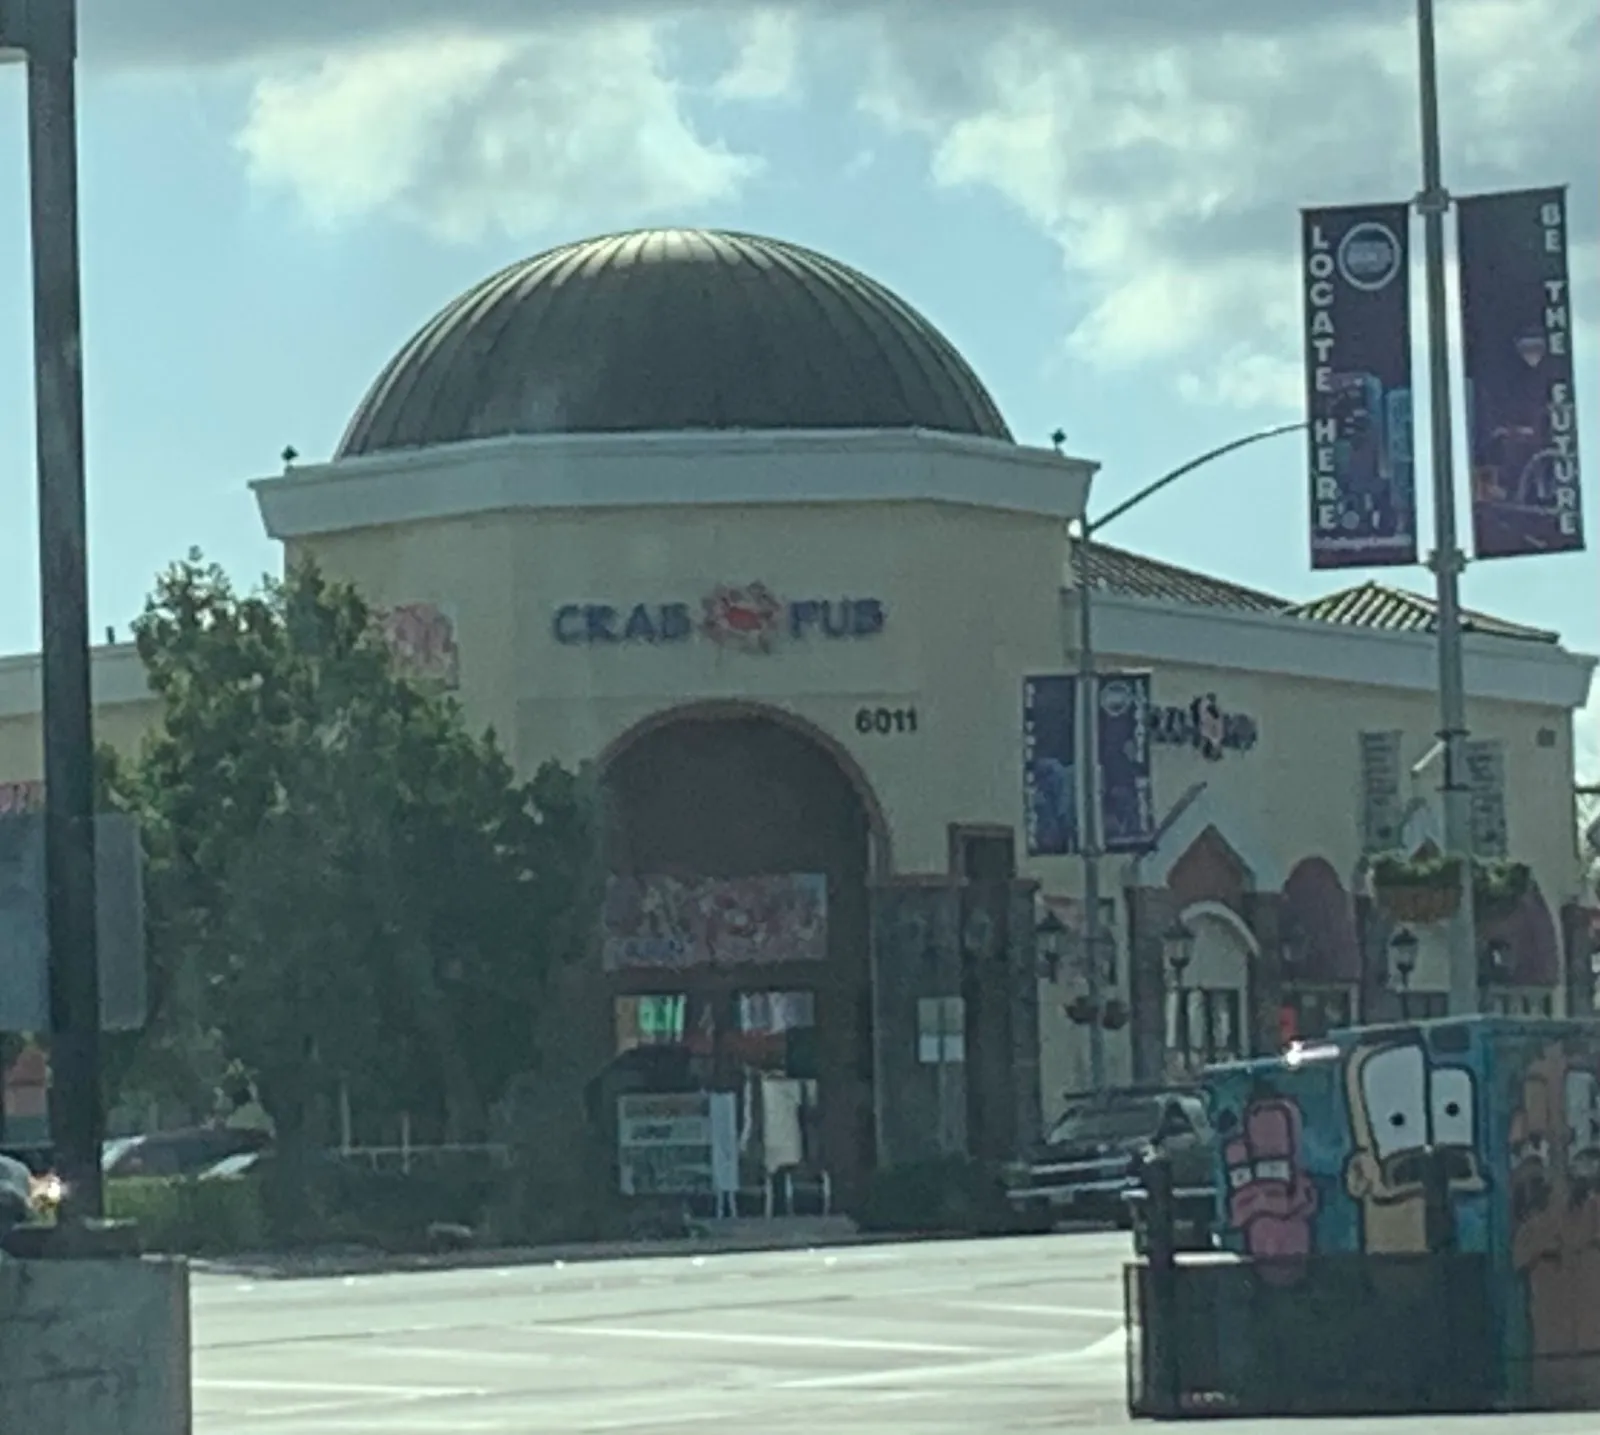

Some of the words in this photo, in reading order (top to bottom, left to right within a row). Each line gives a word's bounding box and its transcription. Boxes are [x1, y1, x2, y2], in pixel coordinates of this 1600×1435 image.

[1540, 203, 1561, 251] BE
[1309, 226, 1336, 393] LOCATE
[1544, 280, 1565, 354] THE
[1313, 419, 1340, 530] HERE
[1550, 384, 1578, 535] FUTURE
[552, 601, 691, 645] CRAB
[788, 597, 886, 640] PUB
[855, 706, 918, 735] 6011
